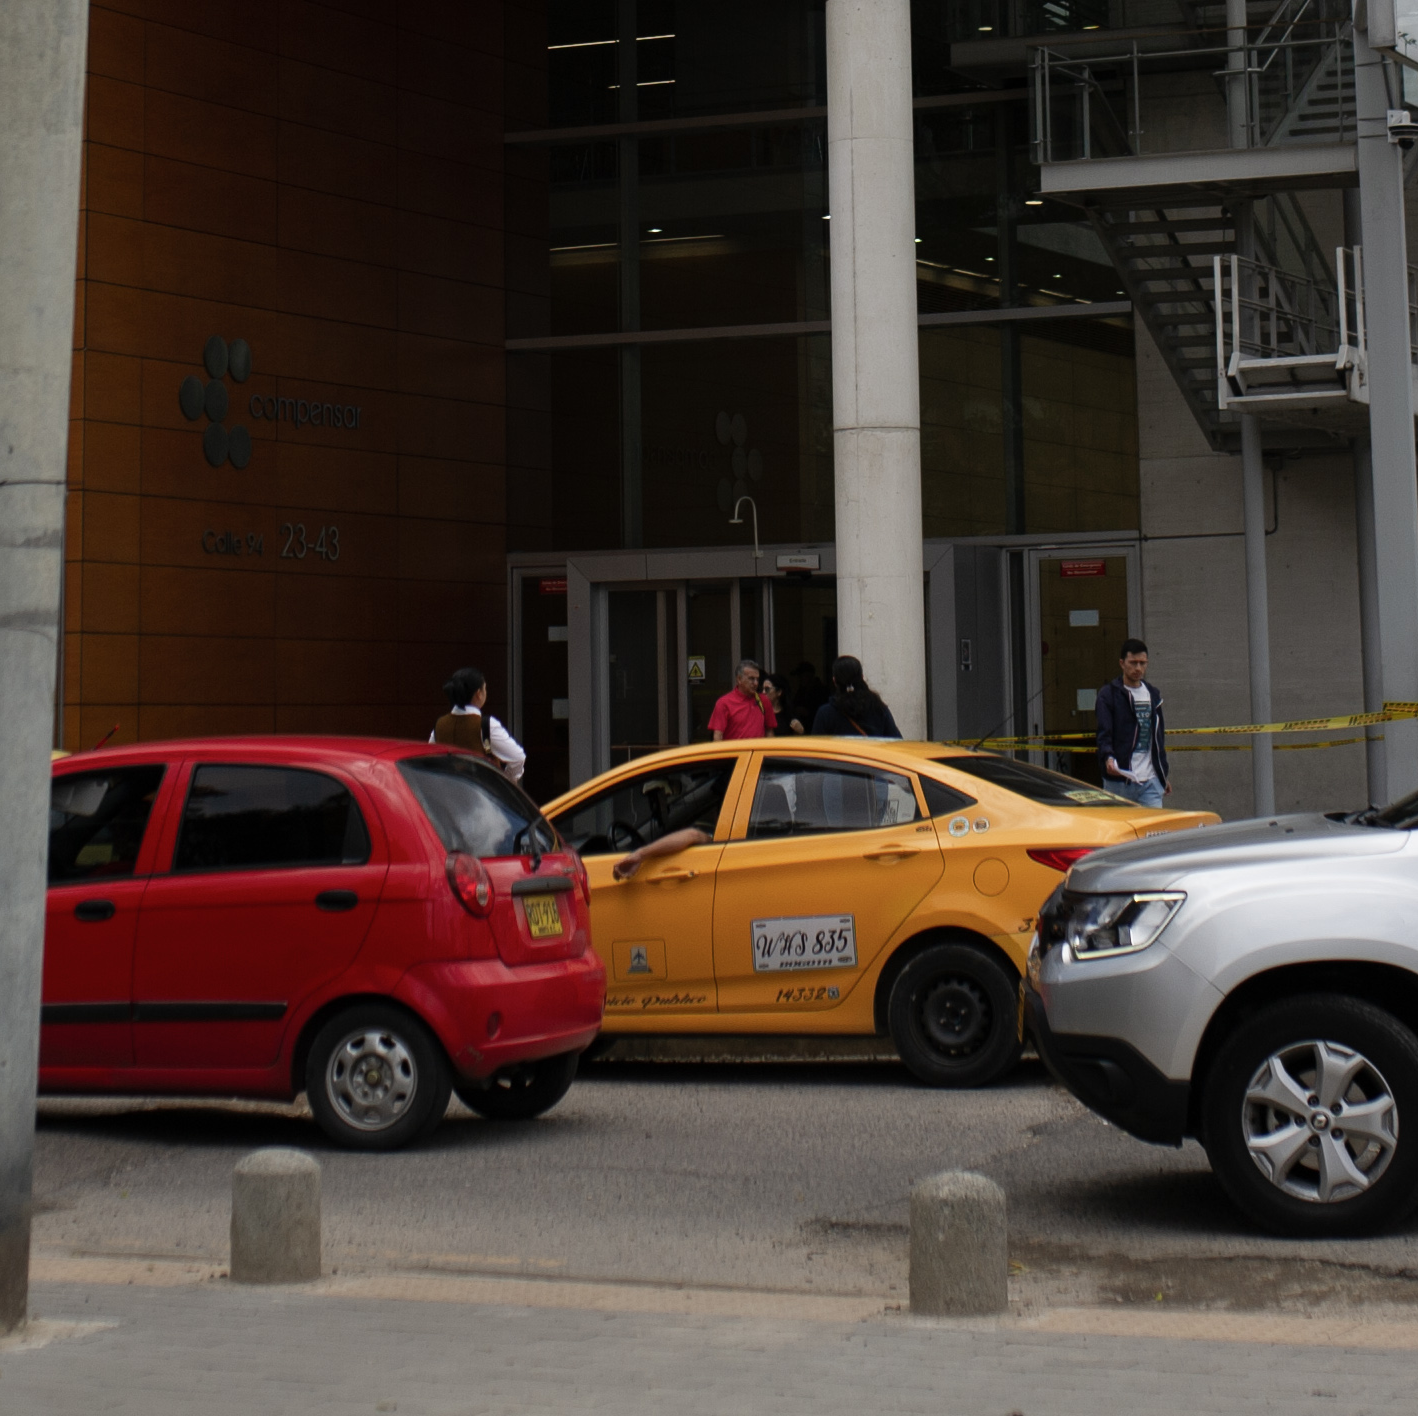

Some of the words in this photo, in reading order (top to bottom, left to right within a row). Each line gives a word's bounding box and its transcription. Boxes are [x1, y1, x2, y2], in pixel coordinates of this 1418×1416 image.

[249, 394, 362, 429] compensar
[202, 529, 242, 556] Calle
[246, 532, 264, 556] 94
[279, 522, 341, 561] 23-43
[812, 927, 851, 955] 835
[775, 986, 827, 1003] 14332
